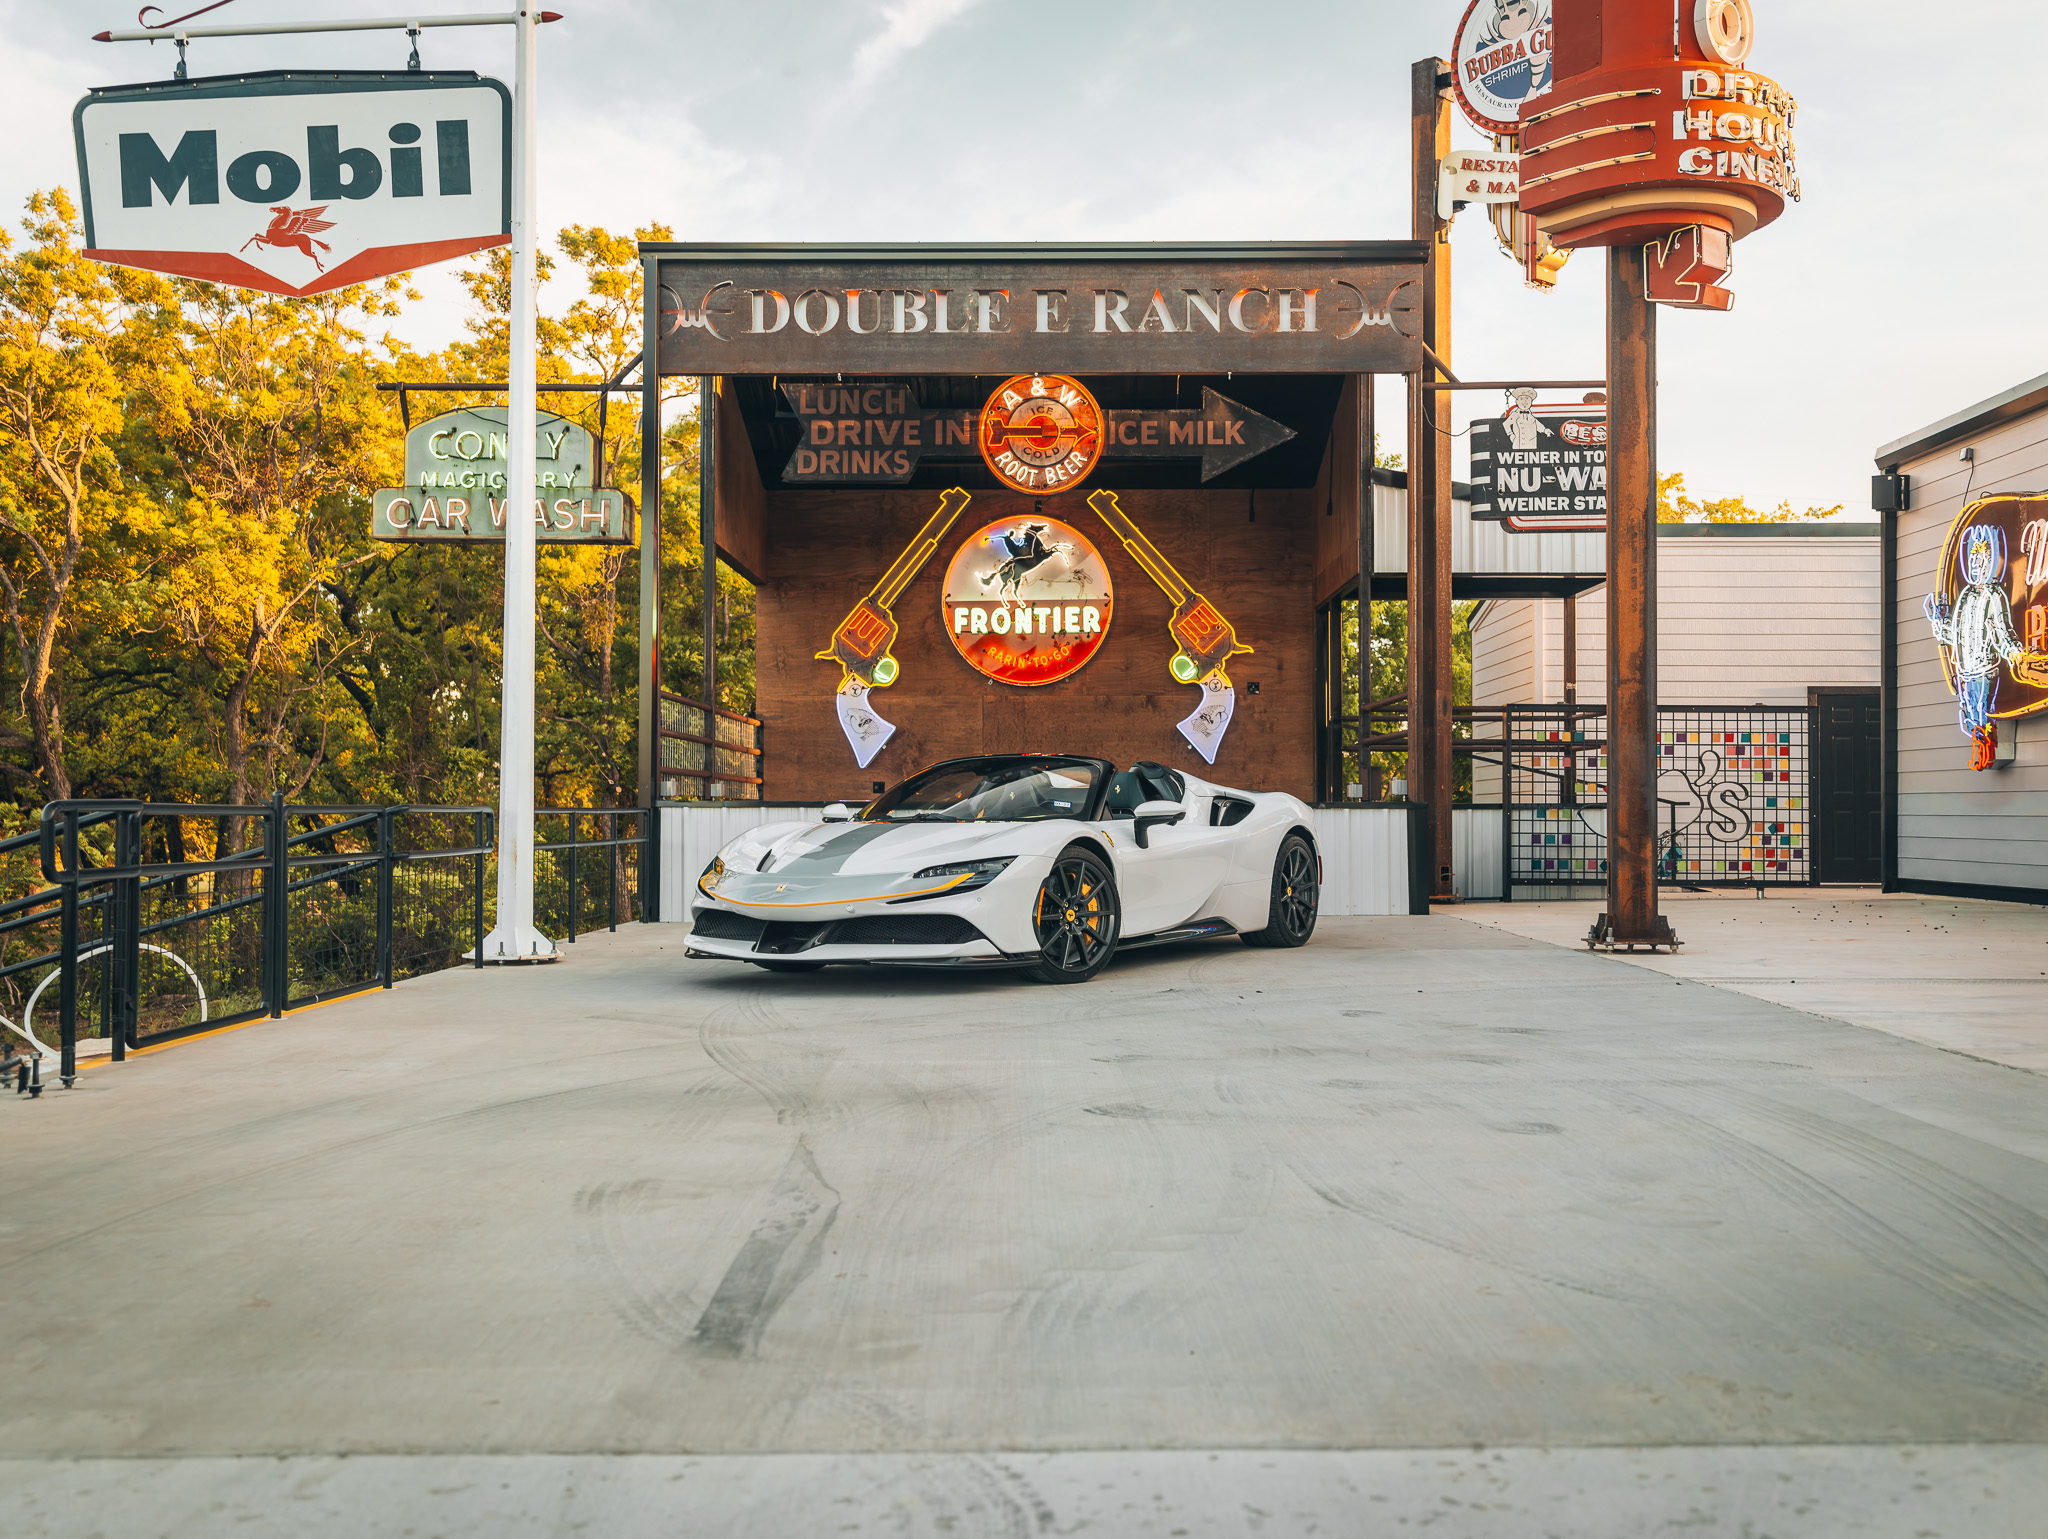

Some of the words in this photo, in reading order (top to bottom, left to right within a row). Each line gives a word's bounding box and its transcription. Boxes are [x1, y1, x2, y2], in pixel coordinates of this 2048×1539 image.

[1465, 38, 1527, 83] BUBBA
[1485, 63, 1529, 87] SHRIMP
[1474, 84, 1520, 109] RESTAURANT
[119, 119, 472, 209] Mobil
[1460, 157, 1519, 173] RESTA
[1466, 179, 1480, 193] &
[742, 289, 1012, 335] DOUBLE
[1031, 288, 1070, 333] E
[1089, 287, 1322, 334] RANCH
[799, 388, 905, 415] LUNCH
[1003, 390, 1023, 410] A
[1031, 378, 1048, 396] &
[1060, 384, 1082, 407] W
[1031, 405, 1054, 416] ICE
[810, 419, 921, 445] DRIVE
[935, 419, 970, 445] IN
[1109, 420, 1158, 445] ICE
[1169, 420, 1245, 445] MILK
[1564, 422, 1606, 443] BES
[429, 430, 568, 461] CONY
[1023, 447, 1060, 459] COLD
[1497, 451, 1561, 465] WEINER
[1564, 451, 1580, 464] IN
[1583, 450, 1606, 464] TO
[797, 449, 910, 475] DRINKS
[995, 451, 1038, 486] ROOT
[1045, 451, 1088, 485] BEER
[420, 471, 504, 489] MAGIC
[533, 471, 576, 489] RY
[1497, 466, 1606, 493] NU-WA
[386, 496, 472, 533] CAR
[1497, 496, 1569, 512] WEINER
[1573, 495, 1606, 511] STA
[954, 606, 1102, 635] FRONTIER
